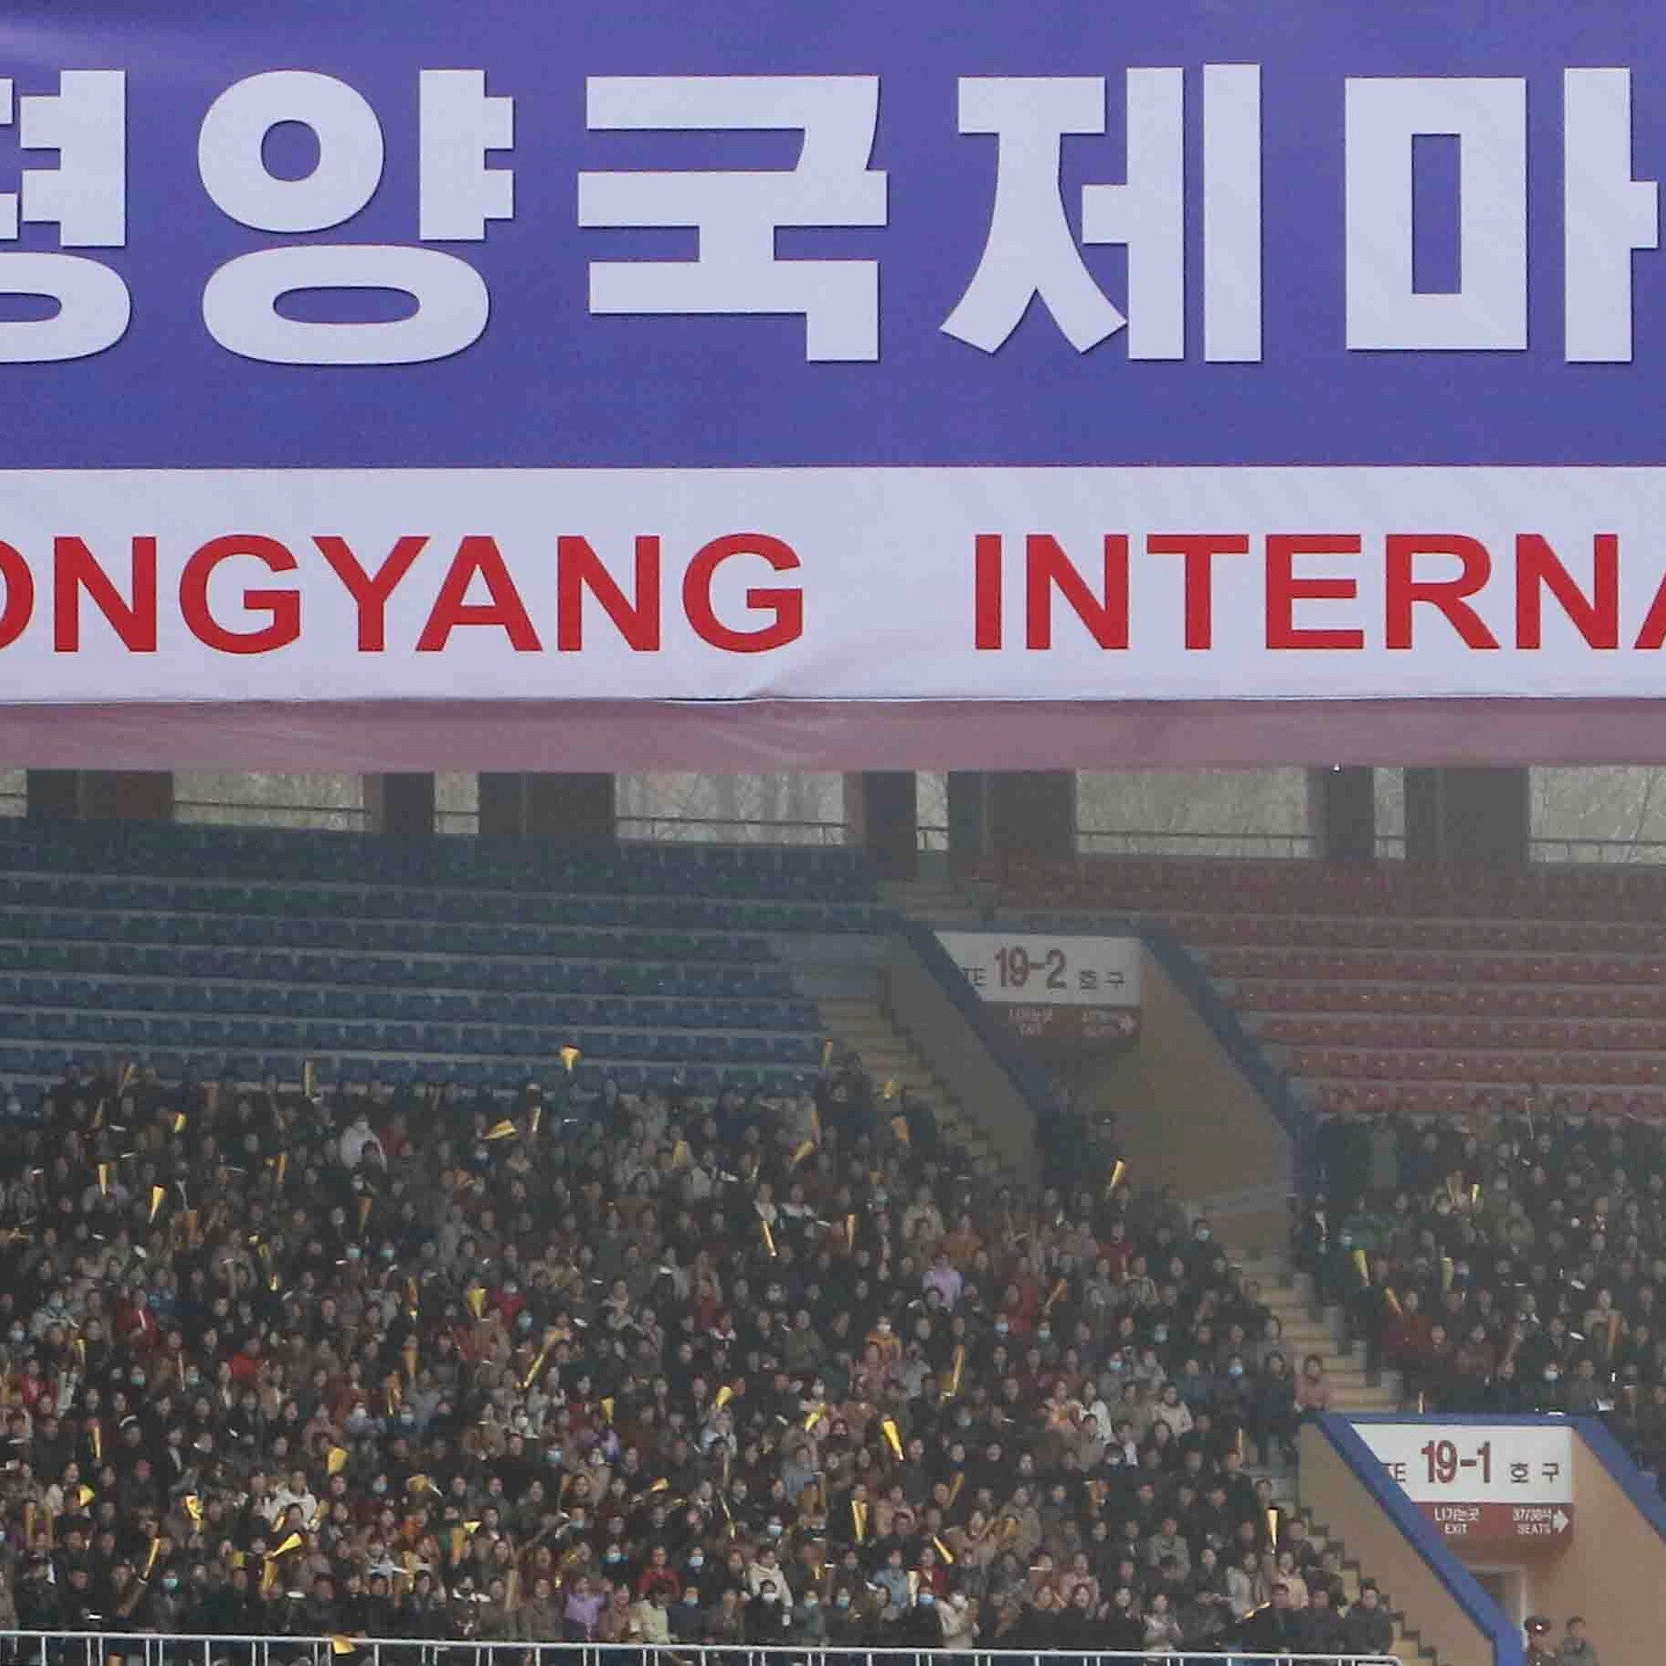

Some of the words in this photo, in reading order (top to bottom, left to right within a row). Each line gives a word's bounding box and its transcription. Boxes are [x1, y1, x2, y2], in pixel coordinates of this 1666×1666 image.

[994, 946, 1067, 989] 19-2
[1421, 1440, 1491, 1484] 19-1
[1445, 1522, 1468, 1535] EXIT
